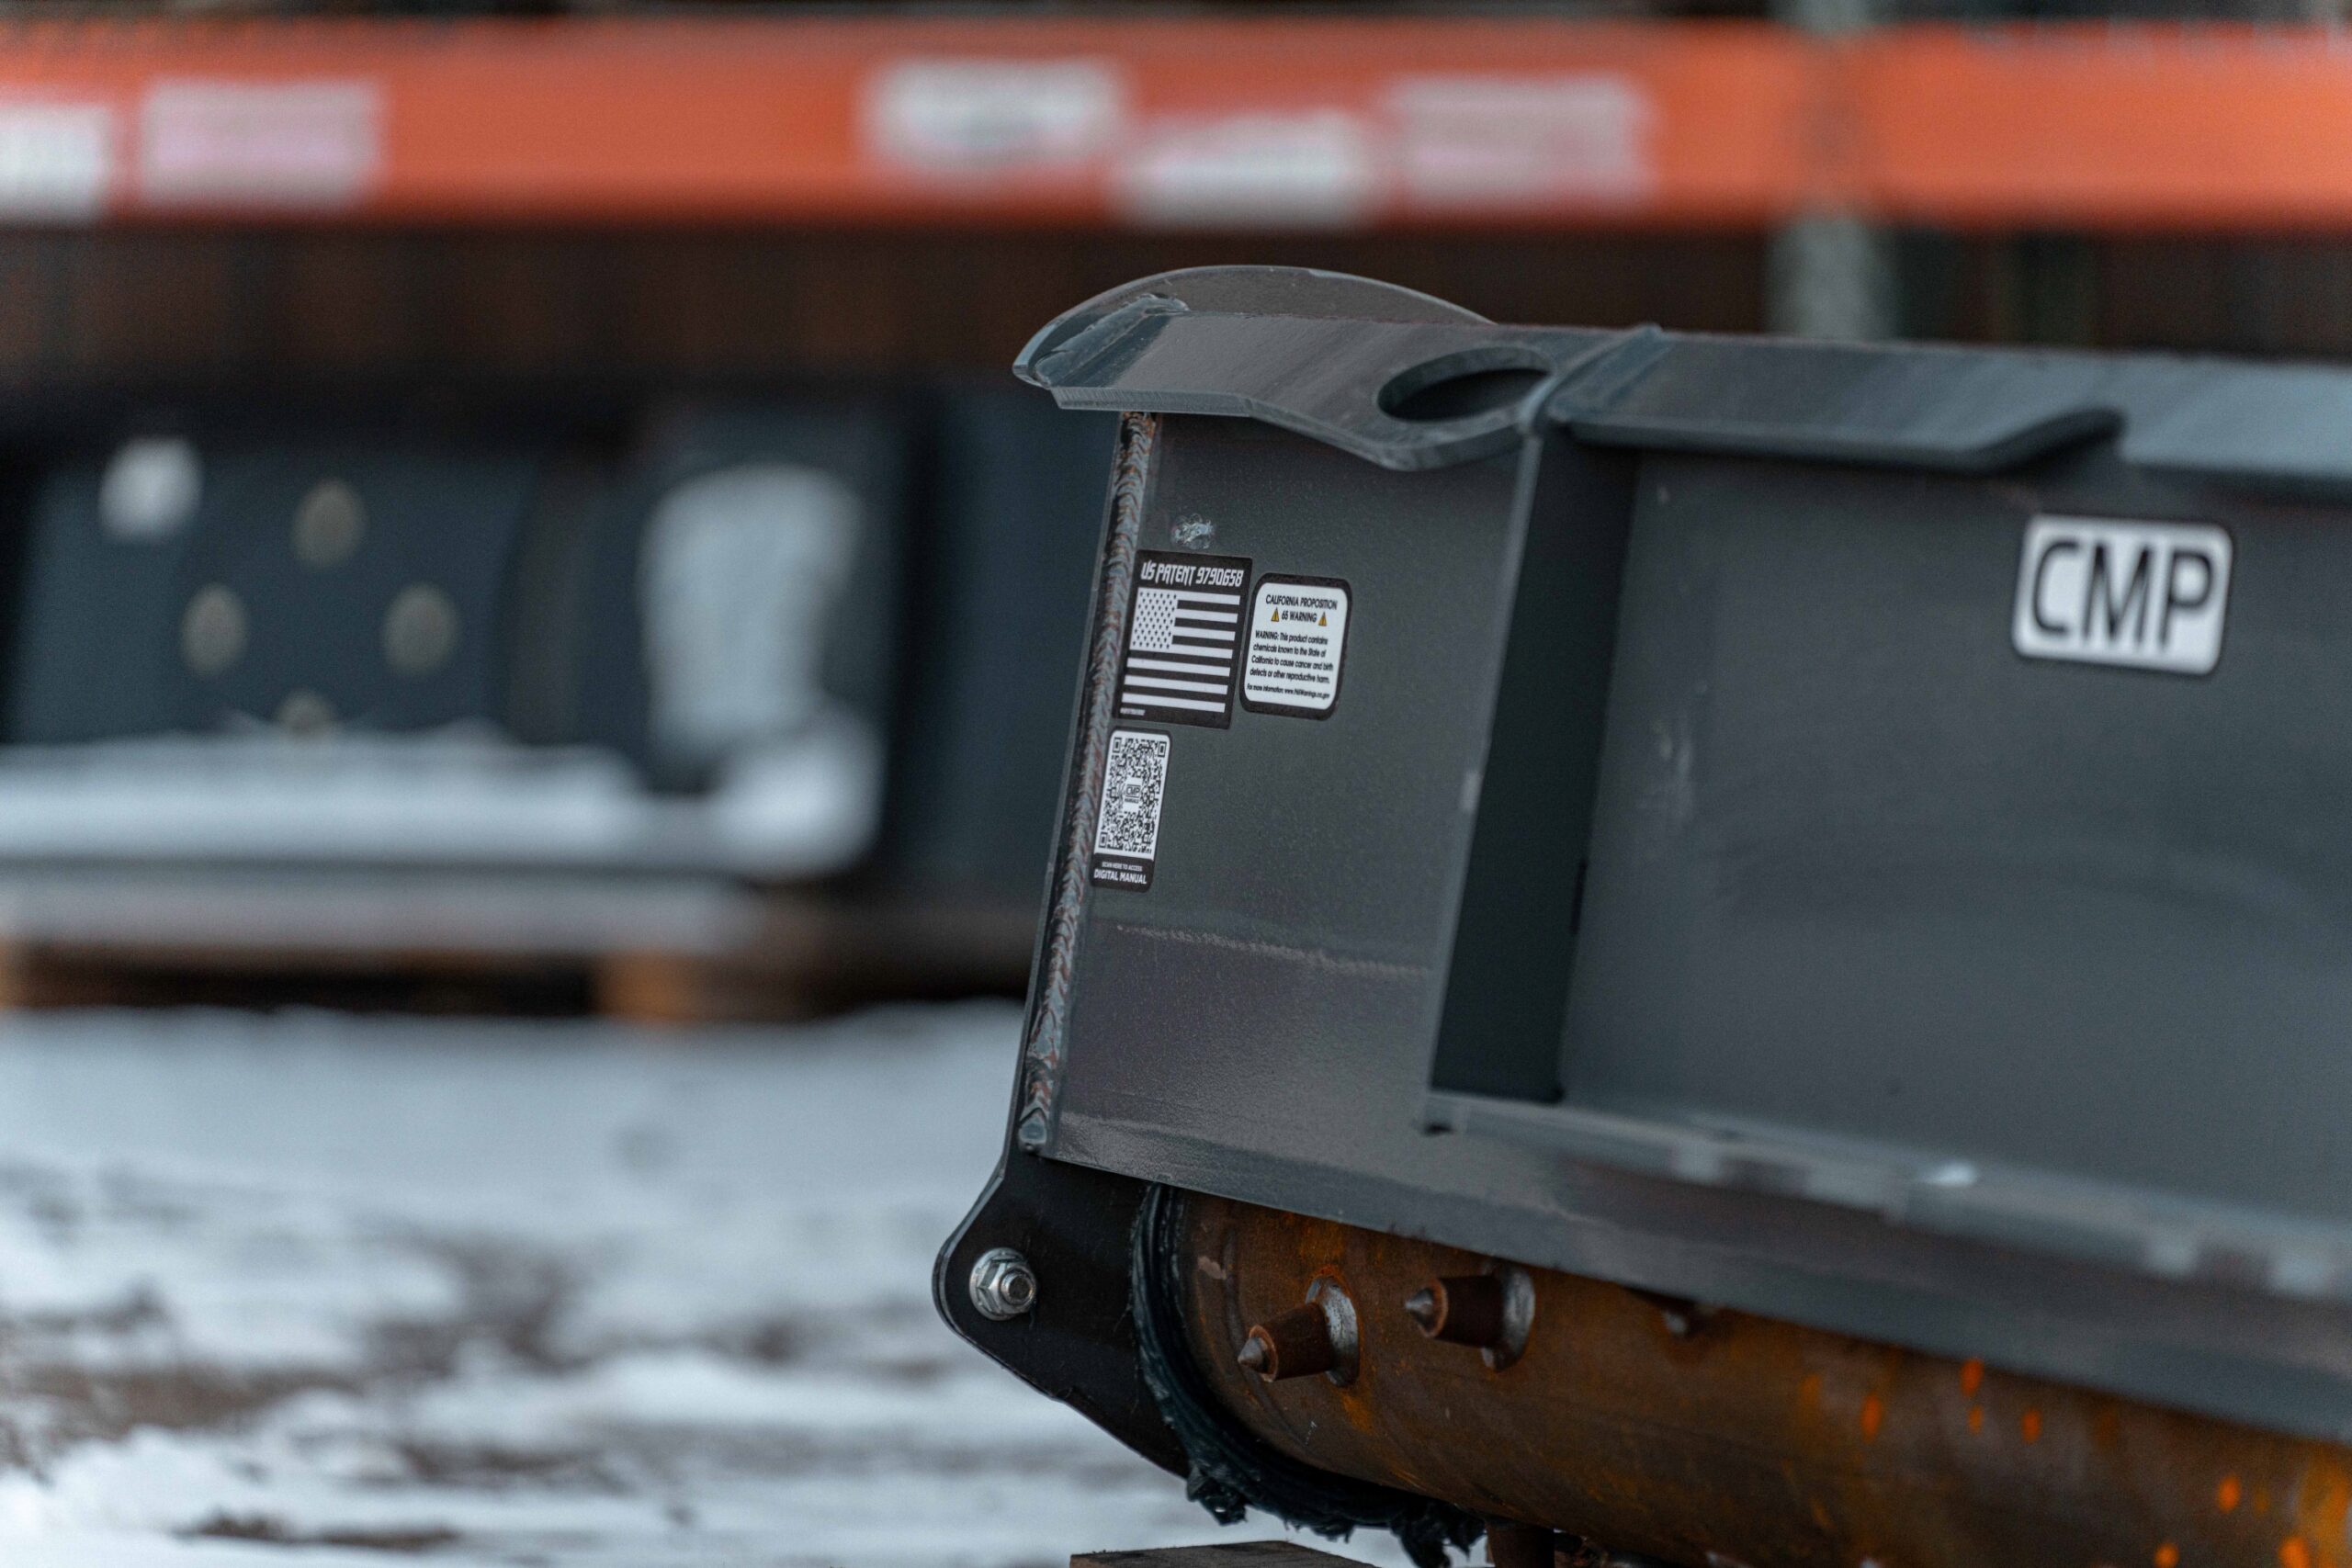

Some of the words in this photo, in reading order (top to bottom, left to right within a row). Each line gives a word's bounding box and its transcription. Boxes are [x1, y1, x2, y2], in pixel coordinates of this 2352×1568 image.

[1140, 560, 1156, 580] US
[1155, 563, 1196, 587] PATENT
[1196, 567, 1244, 587] 9790658
[2031, 538, 2213, 648] CMP
[1266, 594, 1298, 607] CALIFORNIA
[1300, 597, 1338, 611] PROPOSITION
[1282, 610, 1289, 621] 65
[1290, 611, 1317, 623] WARNING
[1255, 630, 1279, 640] WARNING:
[1280, 632, 1288, 641] This
[1288, 634, 1307, 643] product
[1308, 637, 1329, 645] contains
[1253, 644, 1277, 653] chemicals
[1278, 646, 1294, 655] known
[1294, 647, 1300, 655] to
[1251, 655, 1274, 665] California
[1274, 658, 1280, 666] to
[1313, 662, 1323, 671] and
[1250, 668, 1267, 677] defects
[1273, 671, 1285, 679] other
[1286, 672, 1316, 682] reproductive
[1093, 869, 1119, 881] DIGITAL
[1119, 872, 1148, 885] MANUAL
